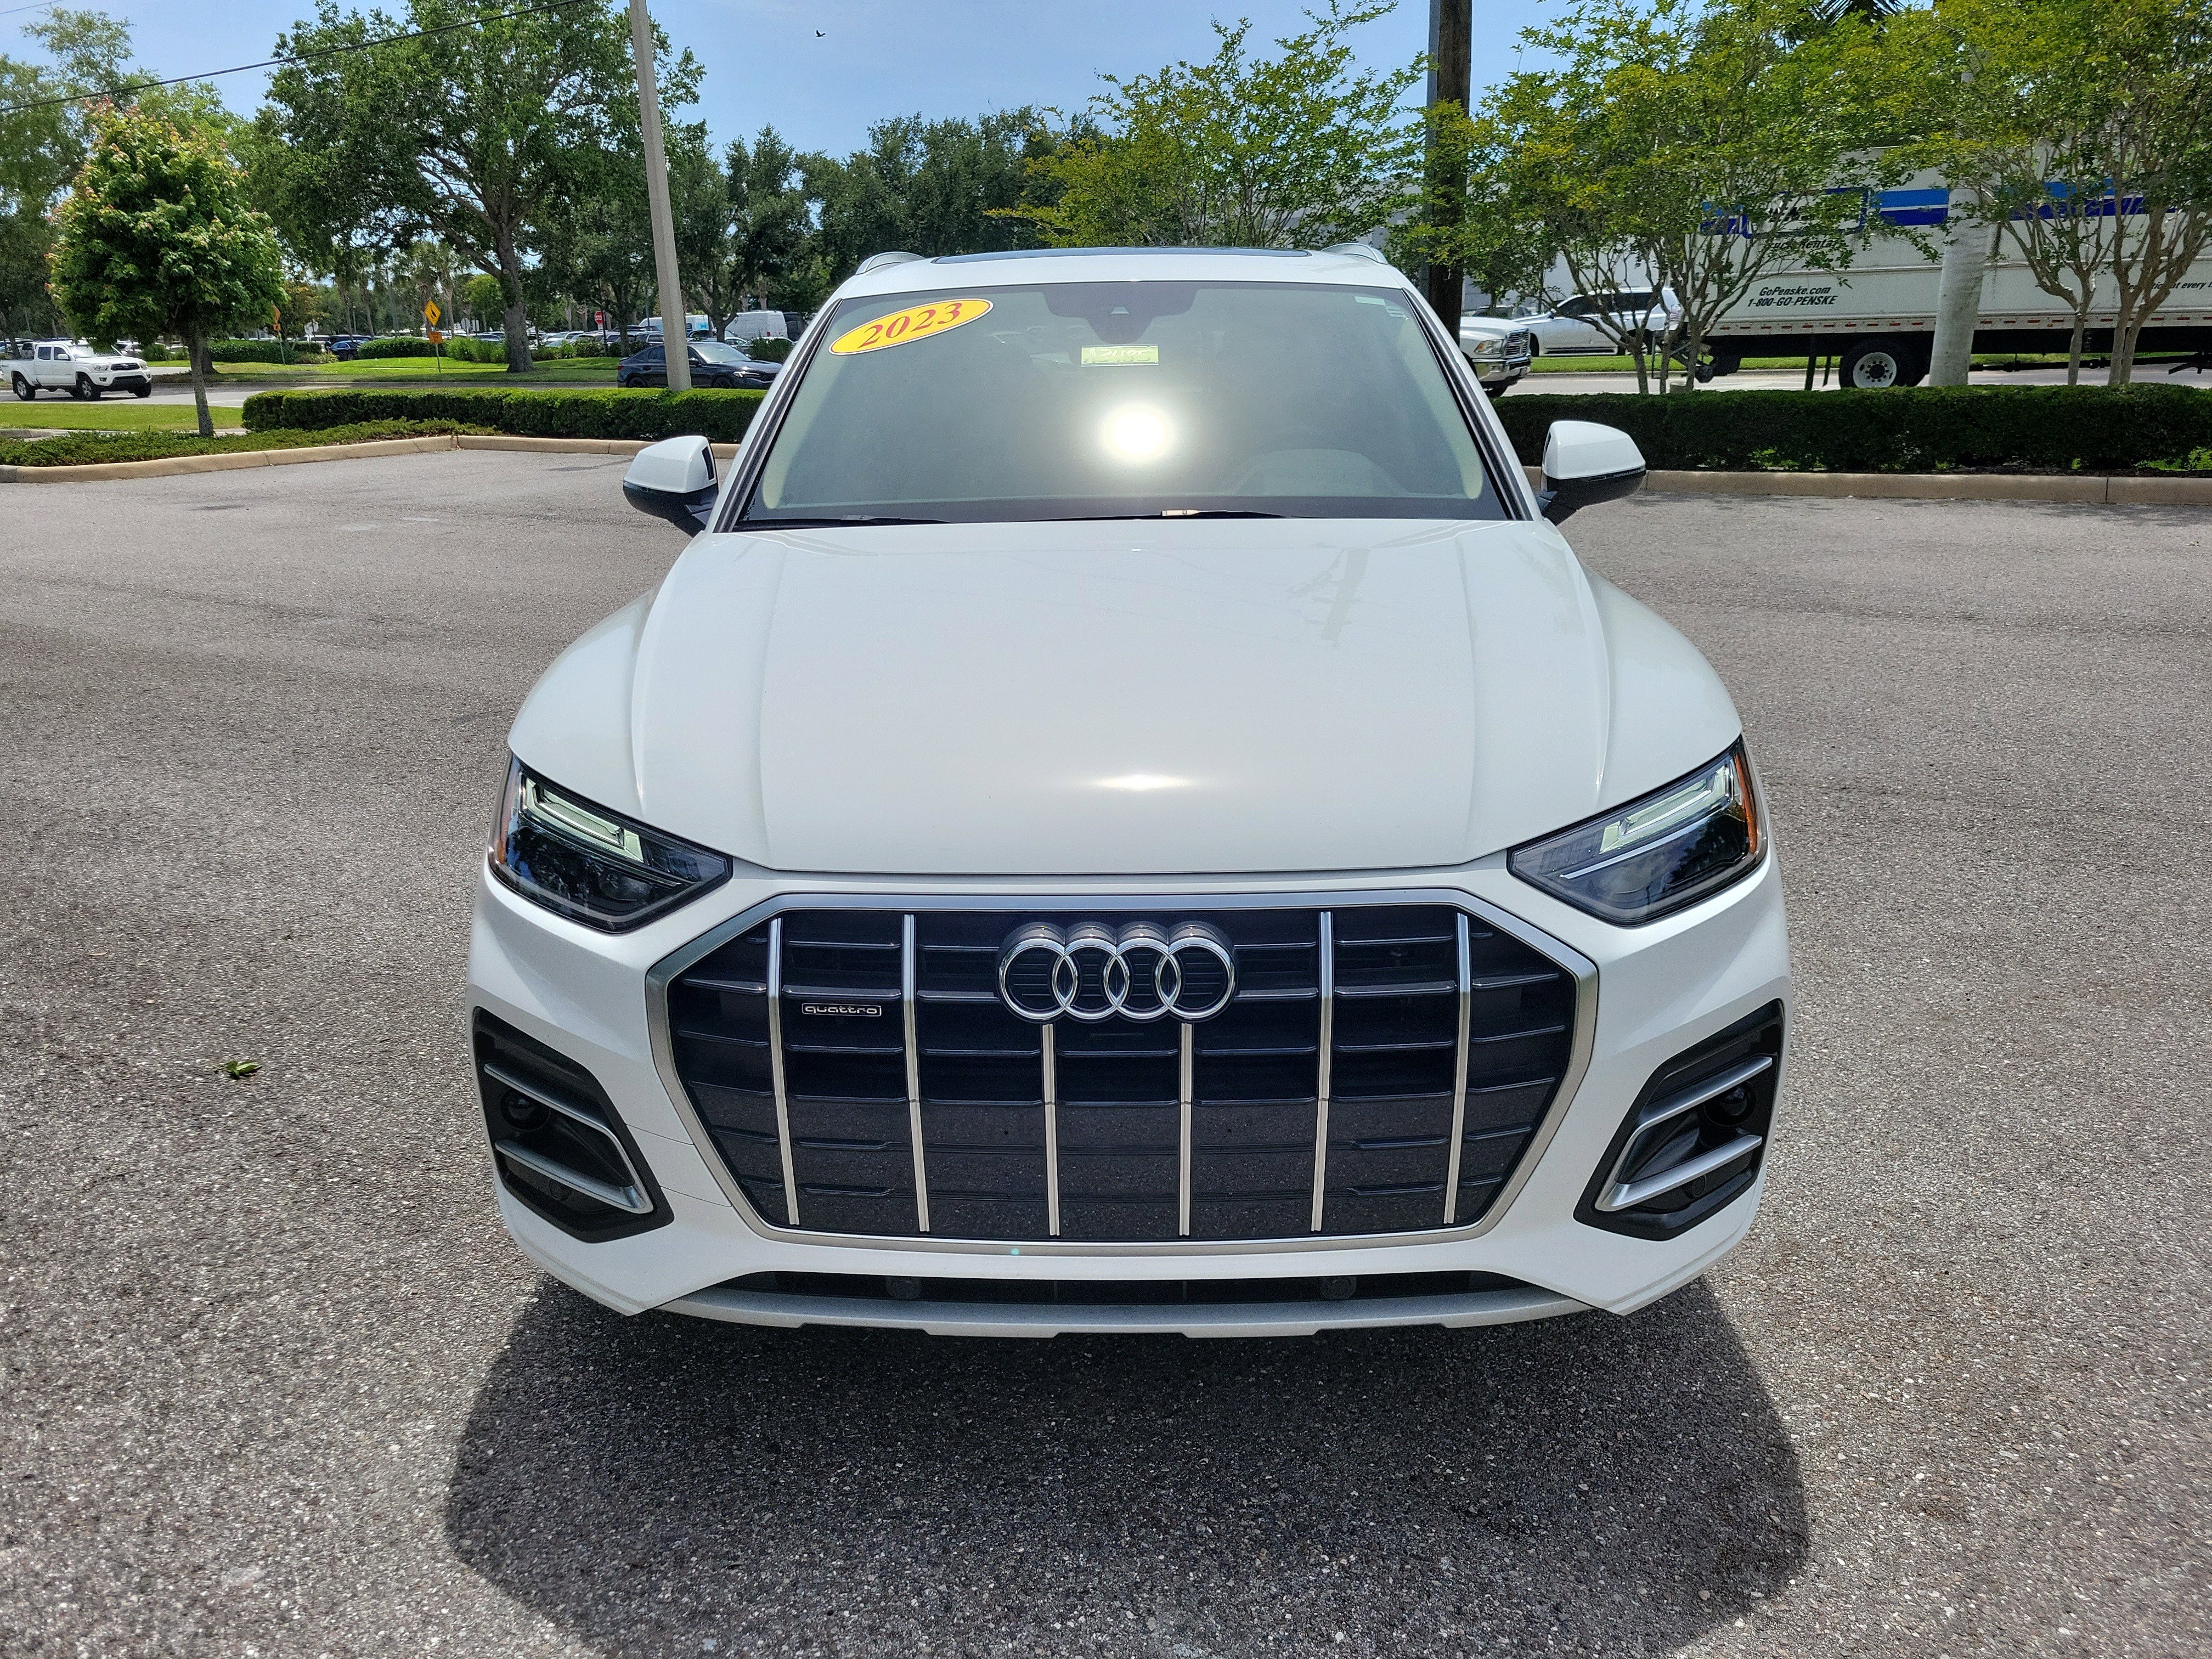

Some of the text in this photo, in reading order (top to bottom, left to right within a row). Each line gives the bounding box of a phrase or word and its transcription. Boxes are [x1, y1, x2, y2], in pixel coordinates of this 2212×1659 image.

[1759, 286, 1831, 296] GoPenske.com
[1748, 296, 1838, 307] 1-800-GO-PENSKE
[857, 303, 962, 348] 2023
[805, 1006, 877, 1014] quattro
